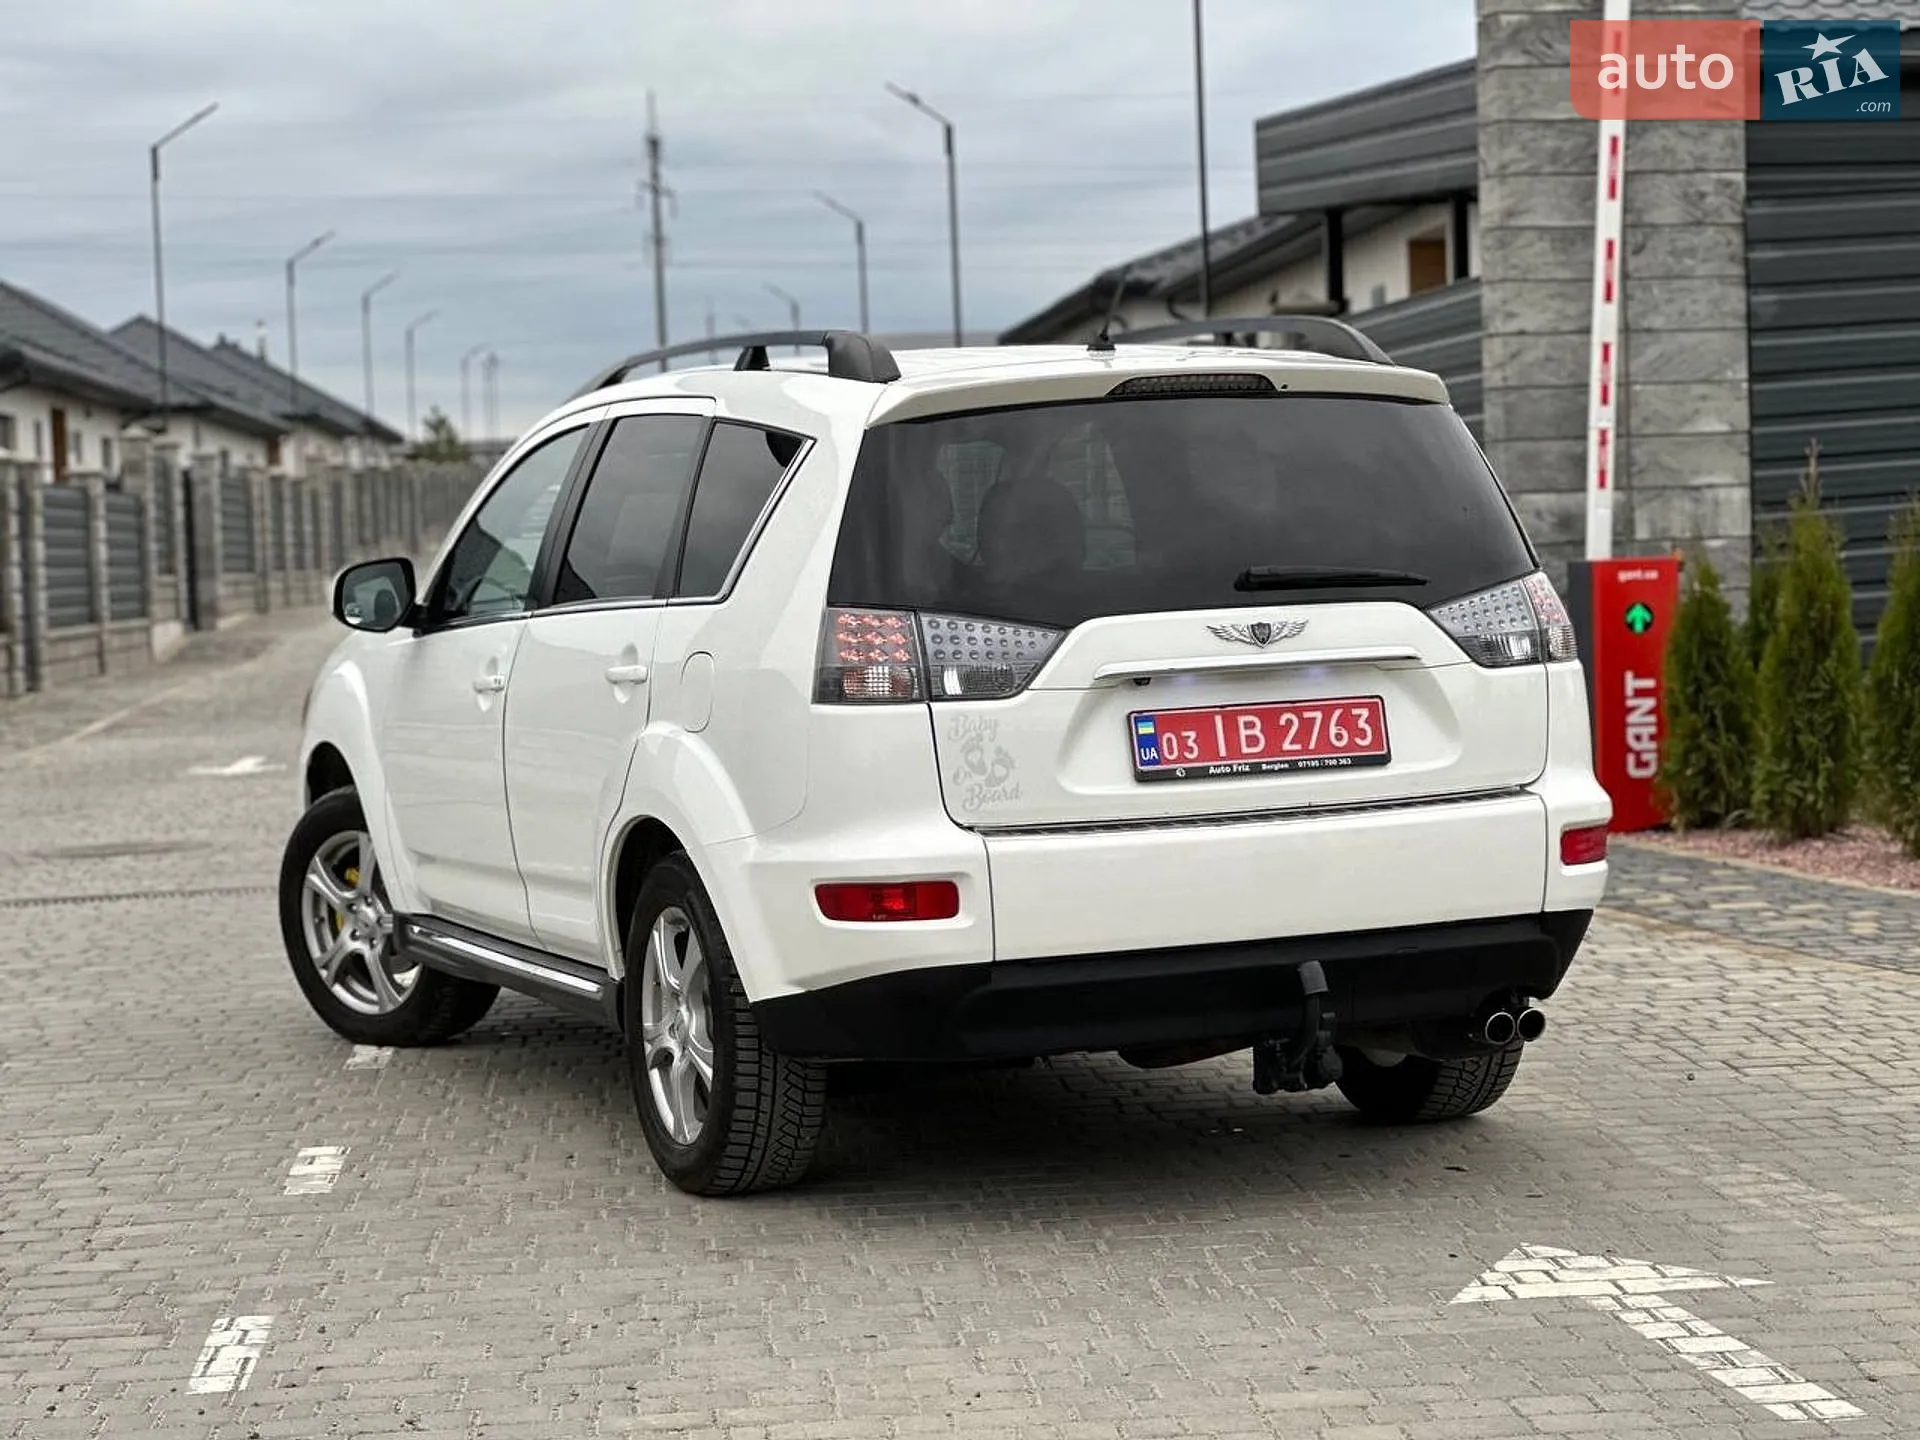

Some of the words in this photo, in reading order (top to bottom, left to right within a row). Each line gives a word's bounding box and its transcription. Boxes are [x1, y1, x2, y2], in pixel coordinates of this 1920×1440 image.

[948, 714, 998, 742] Baby
[1162, 731, 1199, 760] 03
[1213, 714, 1266, 758] IB
[1279, 708, 1373, 751] 2763
[1624, 671, 1658, 779] GANT
[1141, 747, 1158, 760] UA
[1209, 765, 1231, 775] Auto
